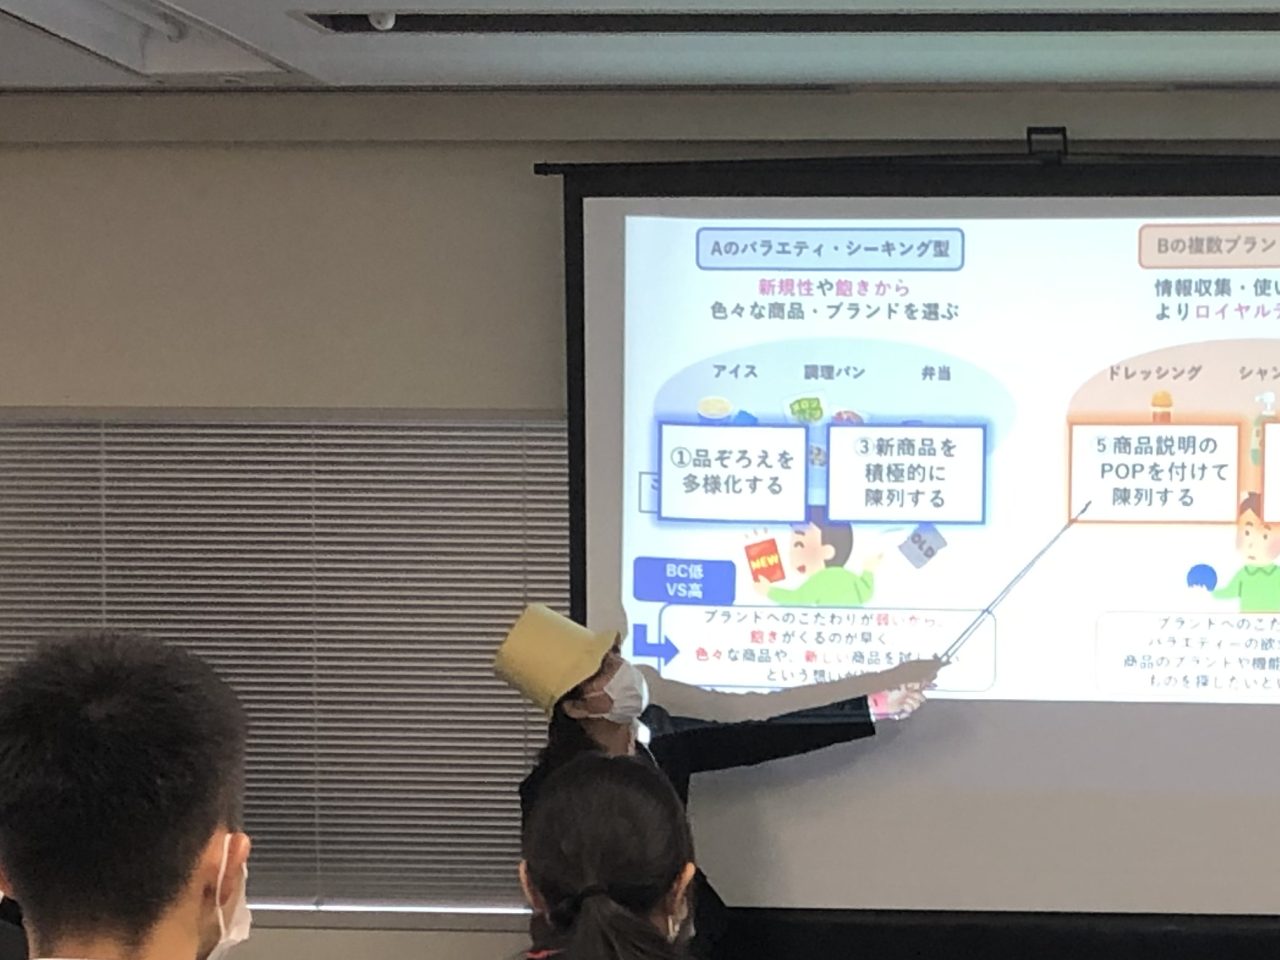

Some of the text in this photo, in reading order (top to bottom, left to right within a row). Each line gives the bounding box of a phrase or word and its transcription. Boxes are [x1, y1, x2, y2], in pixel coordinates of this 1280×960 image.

[711, 239, 950, 258] Aのバラエティ・シーキング型
[758, 278, 910, 297] 新規性や飽きから
[711, 301, 959, 320] 色々な商品・ブランドを選ぶ
[713, 364, 952, 381] アイス 調理パン 弁当
[1108, 364, 1203, 382] ドレッシング
[670, 446, 794, 469] ①品ぞろえを
[864, 462, 946, 483] 積極的に
[1100, 461, 1230, 481] POPを付けて
[683, 474, 784, 495] 多様化する
[864, 488, 945, 508] 陳列する
[1112, 487, 1195, 507] 陳列する
[911, 531, 936, 559] OLD
[666, 563, 704, 579] BC低
[750, 552, 780, 572] NEW
[666, 582, 703, 599] VS高
